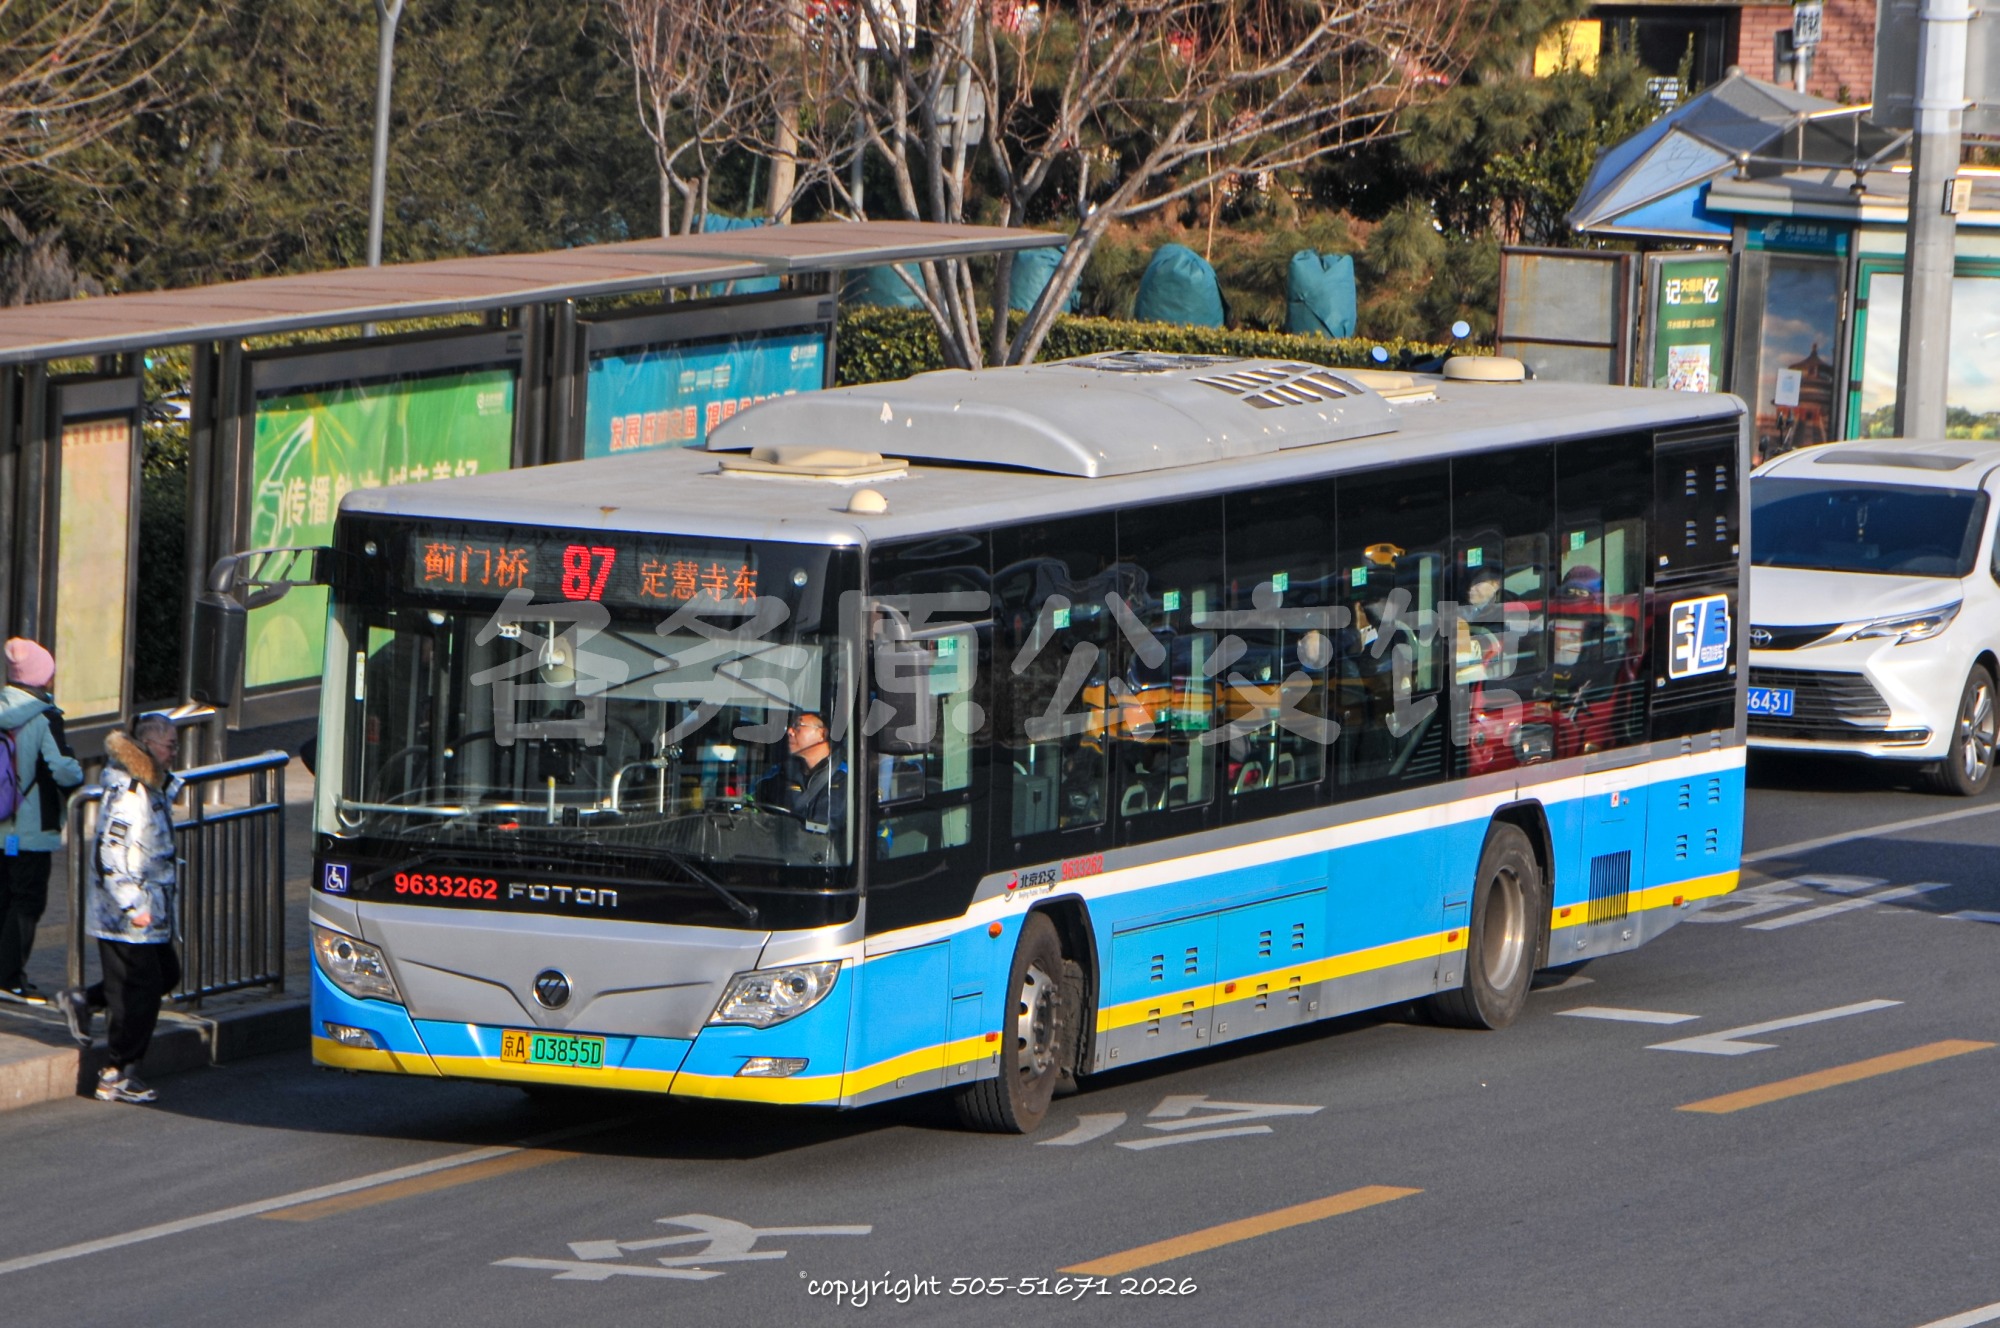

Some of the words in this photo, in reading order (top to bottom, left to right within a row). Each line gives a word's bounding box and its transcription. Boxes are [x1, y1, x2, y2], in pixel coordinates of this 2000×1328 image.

[424, 543, 529, 587] 蓟门桥
[563, 545, 616, 601] 87
[640, 559, 759, 604] 定慧寺东
[1020, 869, 1057, 888] 北京公交
[1061, 854, 1104, 880] 9633262
[395, 872, 498, 900] 9633262
[508, 882, 618, 907] FOTON
